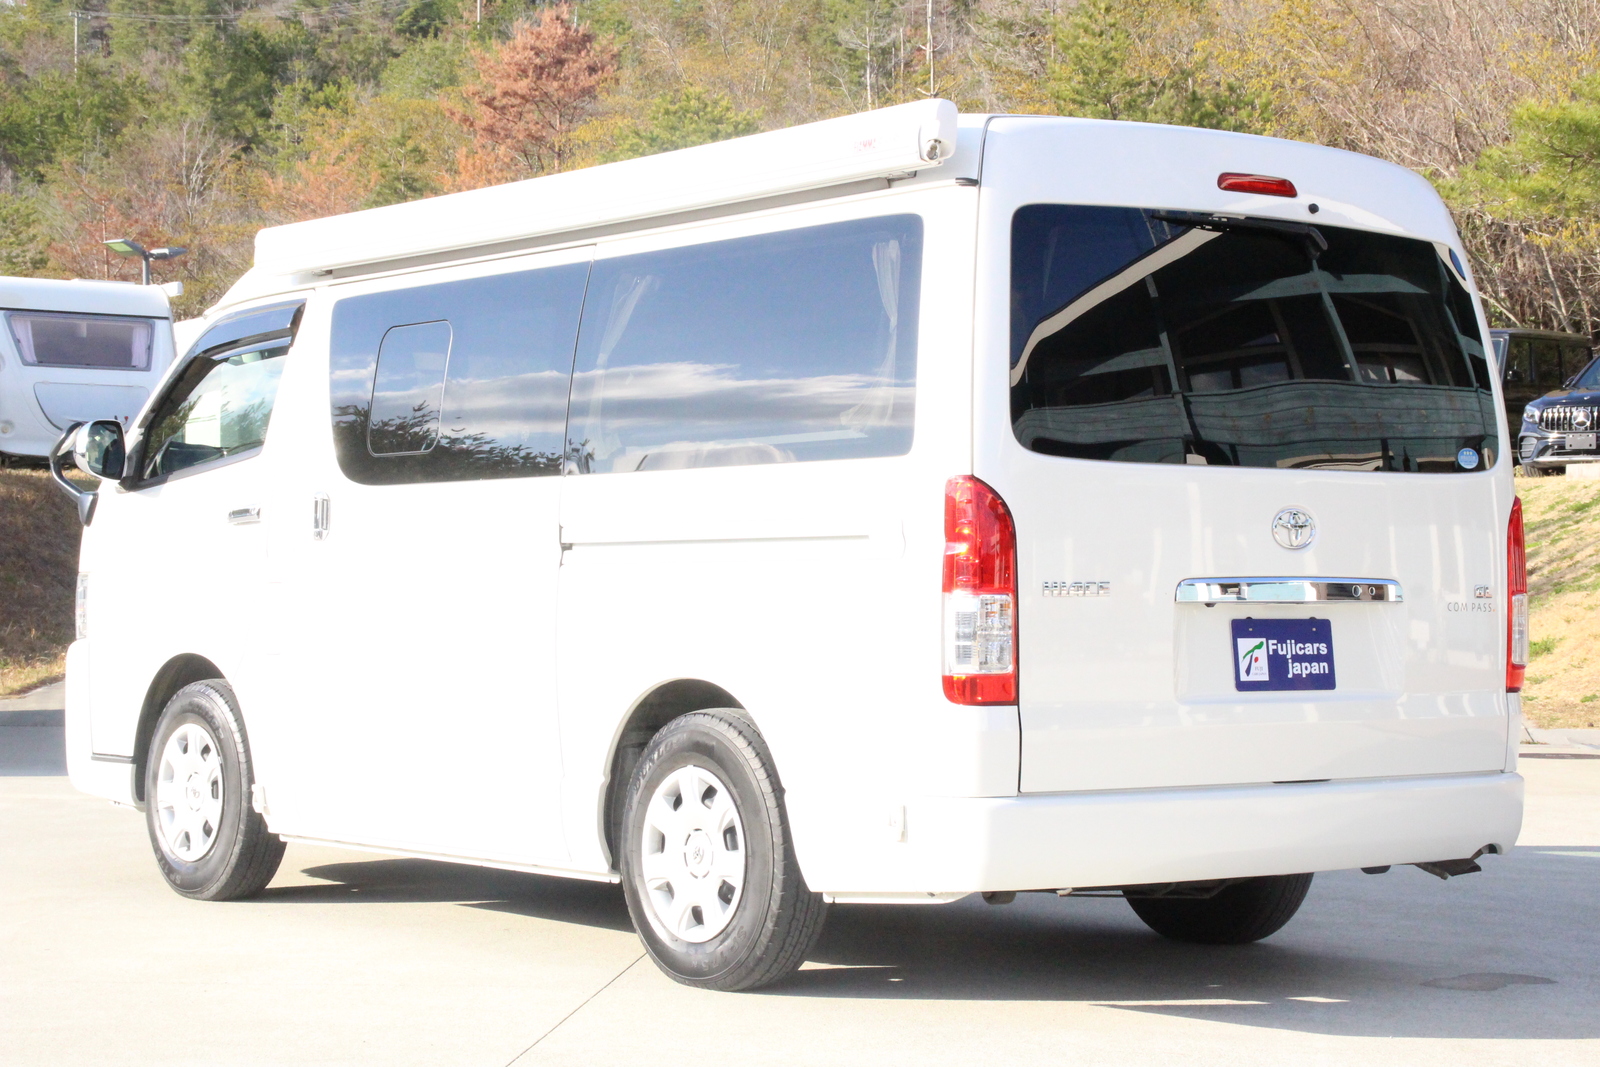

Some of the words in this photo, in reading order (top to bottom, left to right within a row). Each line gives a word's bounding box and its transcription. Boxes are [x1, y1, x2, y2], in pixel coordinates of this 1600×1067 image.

[1042, 581, 1111, 598] HIACE
[1267, 639, 1328, 659] Fujicars
[1287, 658, 1329, 678] japan
